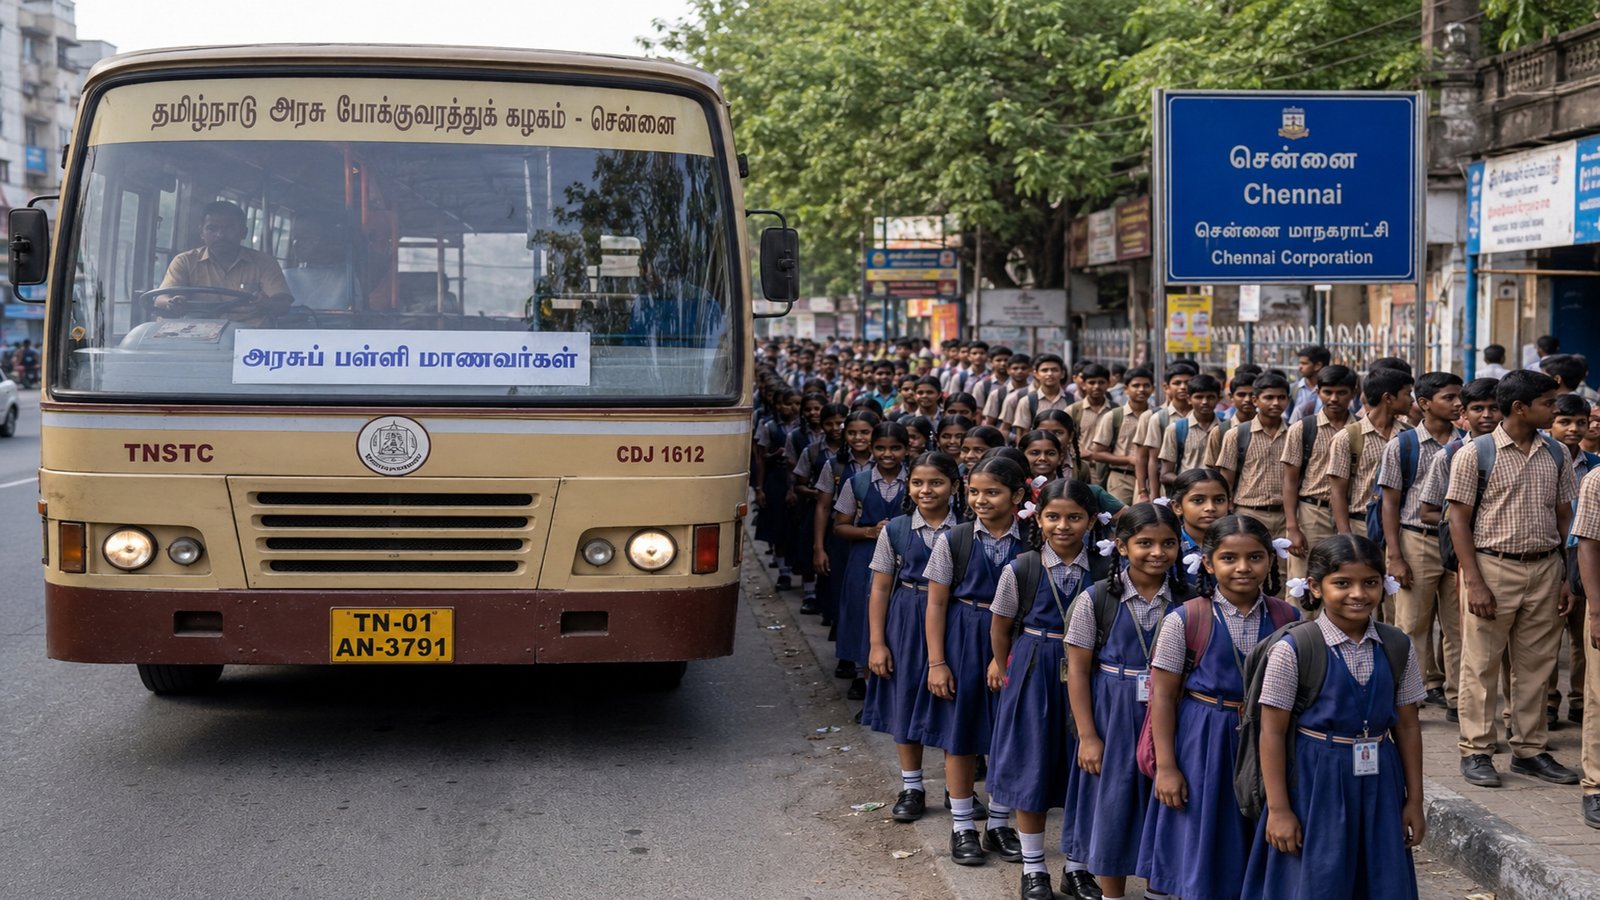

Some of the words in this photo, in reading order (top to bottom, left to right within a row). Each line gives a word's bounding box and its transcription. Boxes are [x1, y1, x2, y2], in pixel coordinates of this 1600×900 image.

[150, 93, 257, 133] தமிழ்நாடு
[269, 96, 327, 129] அரசு
[336, 94, 498, 136] போக்குவரத்துக்
[505, 101, 567, 138] கழகம்
[590, 105, 677, 135] சென்னை
[1229, 144, 1358, 170] சென்னை
[1243, 182, 1342, 205] Chennai
[1194, 221, 1281, 240] சென்னை
[1288, 220, 1390, 243] மாநகராட்சி
[1211, 249, 1276, 265] Chennai
[1280, 249, 1374, 268] Corporation
[242, 345, 325, 371] அரசுப்
[334, 343, 410, 369] பள்ளி
[418, 346, 577, 369] மாணவர்கள்
[123, 442, 214, 464] TNSTC
[616, 445, 655, 464] CDJ
[660, 445, 705, 464] 1612
[353, 612, 434, 633] TN-01
[335, 637, 447, 658] AN-3791
